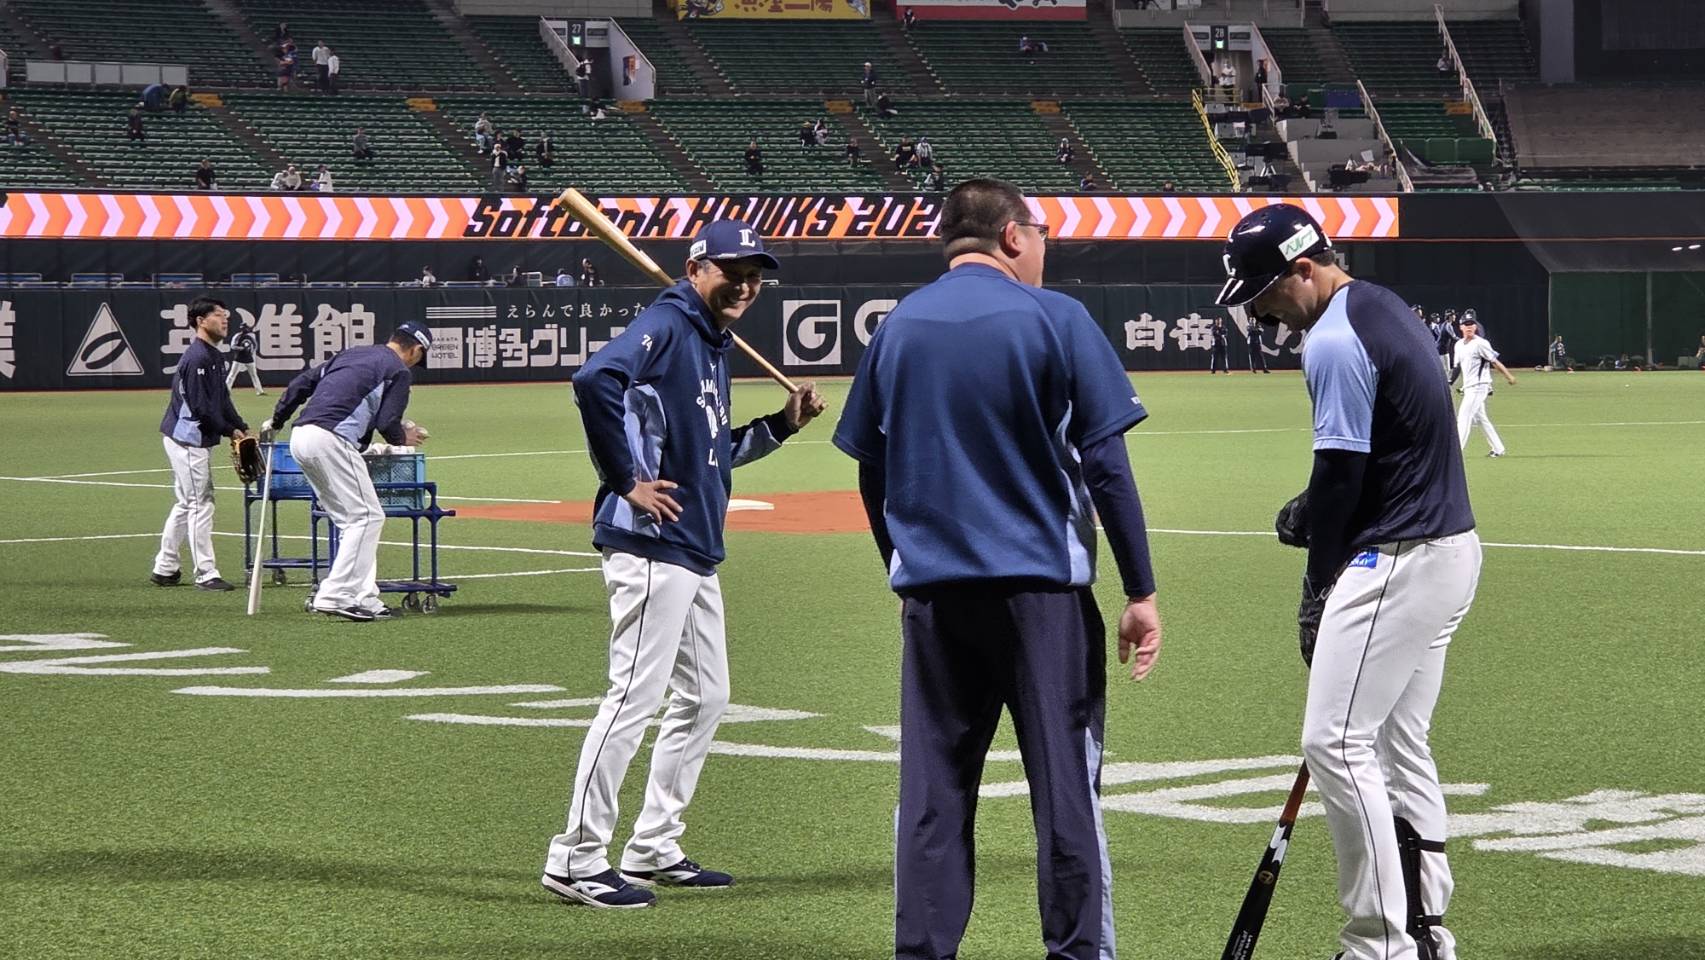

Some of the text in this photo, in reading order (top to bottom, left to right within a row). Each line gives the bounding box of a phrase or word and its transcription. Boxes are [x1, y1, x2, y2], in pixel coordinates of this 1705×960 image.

[571, 23, 582, 34] 27
[1215, 27, 1225, 38] 28
[843, 197, 945, 237] 202
[466, 324, 626, 369] 博多グリー
